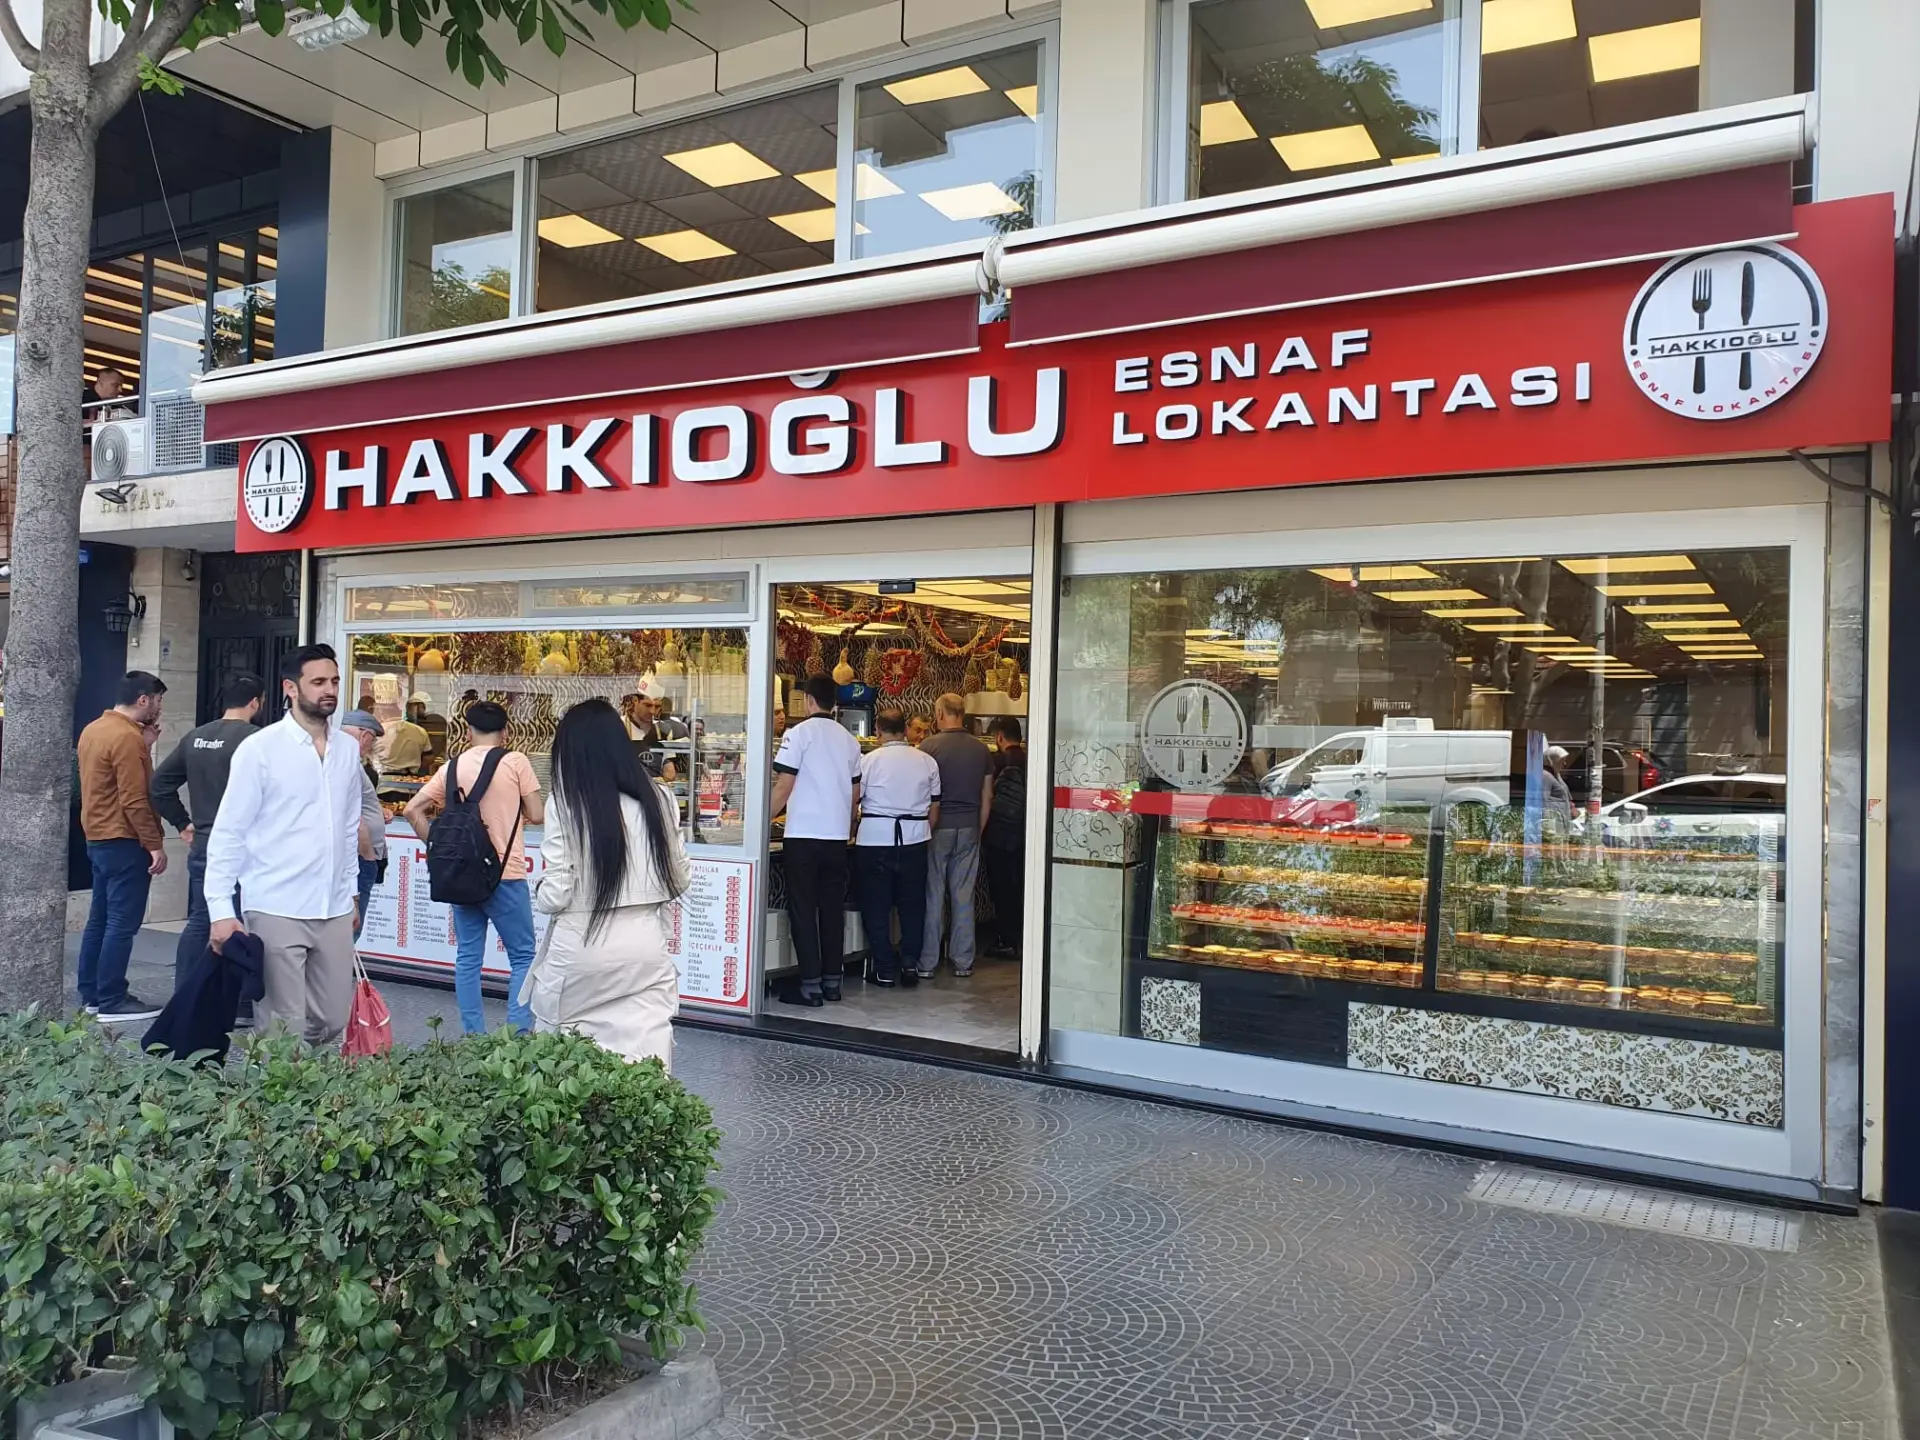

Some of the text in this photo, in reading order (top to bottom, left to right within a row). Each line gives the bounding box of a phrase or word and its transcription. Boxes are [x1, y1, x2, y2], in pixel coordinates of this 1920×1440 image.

[1114, 328, 1369, 393] ESNAF
[1650, 330, 1797, 355] HAKKIOĞLU
[1633, 341, 1818, 413] ESNAF LOKANTASI
[1112, 361, 1591, 445] LOKANTASI
[325, 367, 1062, 510] HAKKIOĞLU
[252, 485, 297, 496] HAKKIOĞLU
[193, 737, 225, 750] Thrasher
[1154, 738, 1232, 748] HAKKIOĞLU
